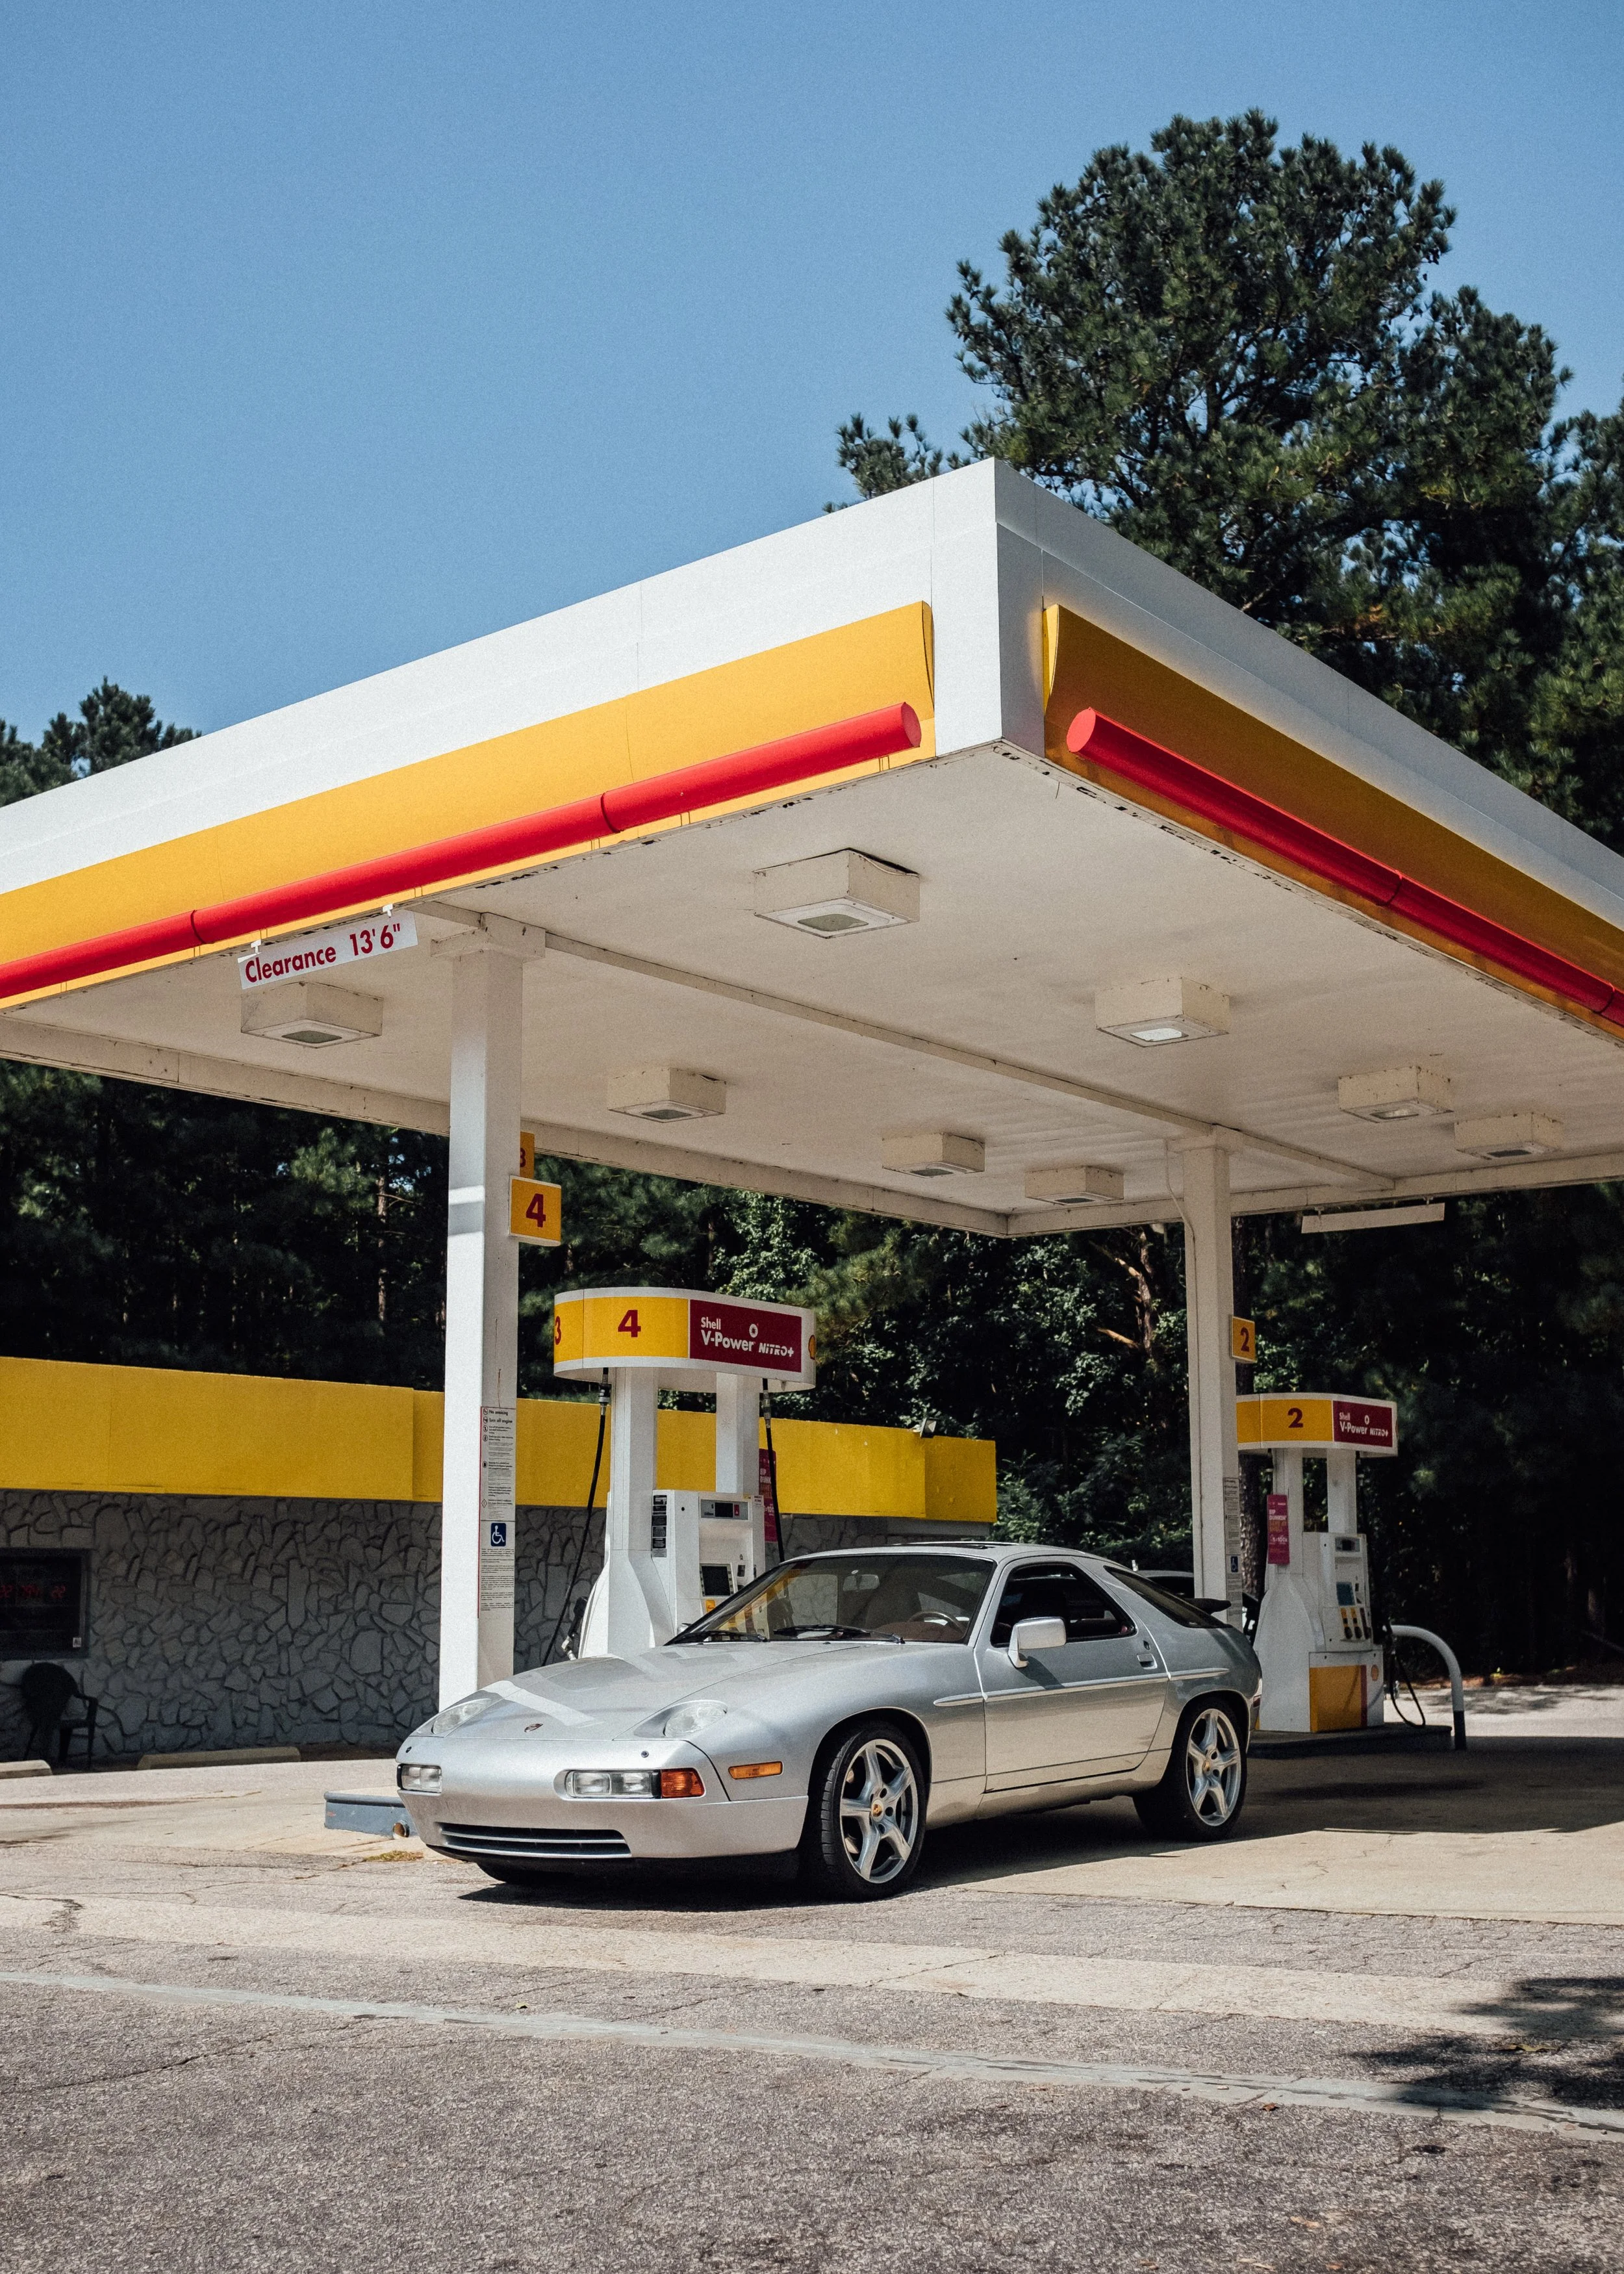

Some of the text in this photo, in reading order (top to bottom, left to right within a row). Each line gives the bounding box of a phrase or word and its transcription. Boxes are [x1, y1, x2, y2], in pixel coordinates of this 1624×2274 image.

[246, 947, 336, 982] Clearance
[526, 1193, 546, 1228] 4
[554, 1315, 562, 1346] 3
[617, 1309, 642, 1338] 4
[700, 1316, 722, 1330] Shell
[700, 1329, 754, 1352] V-Power
[1240, 1327, 1250, 1352] 2
[1287, 1407, 1304, 1429] 2
[1339, 1412, 1351, 1421] Shell
[1339, 1420, 1368, 1435] V-Power
